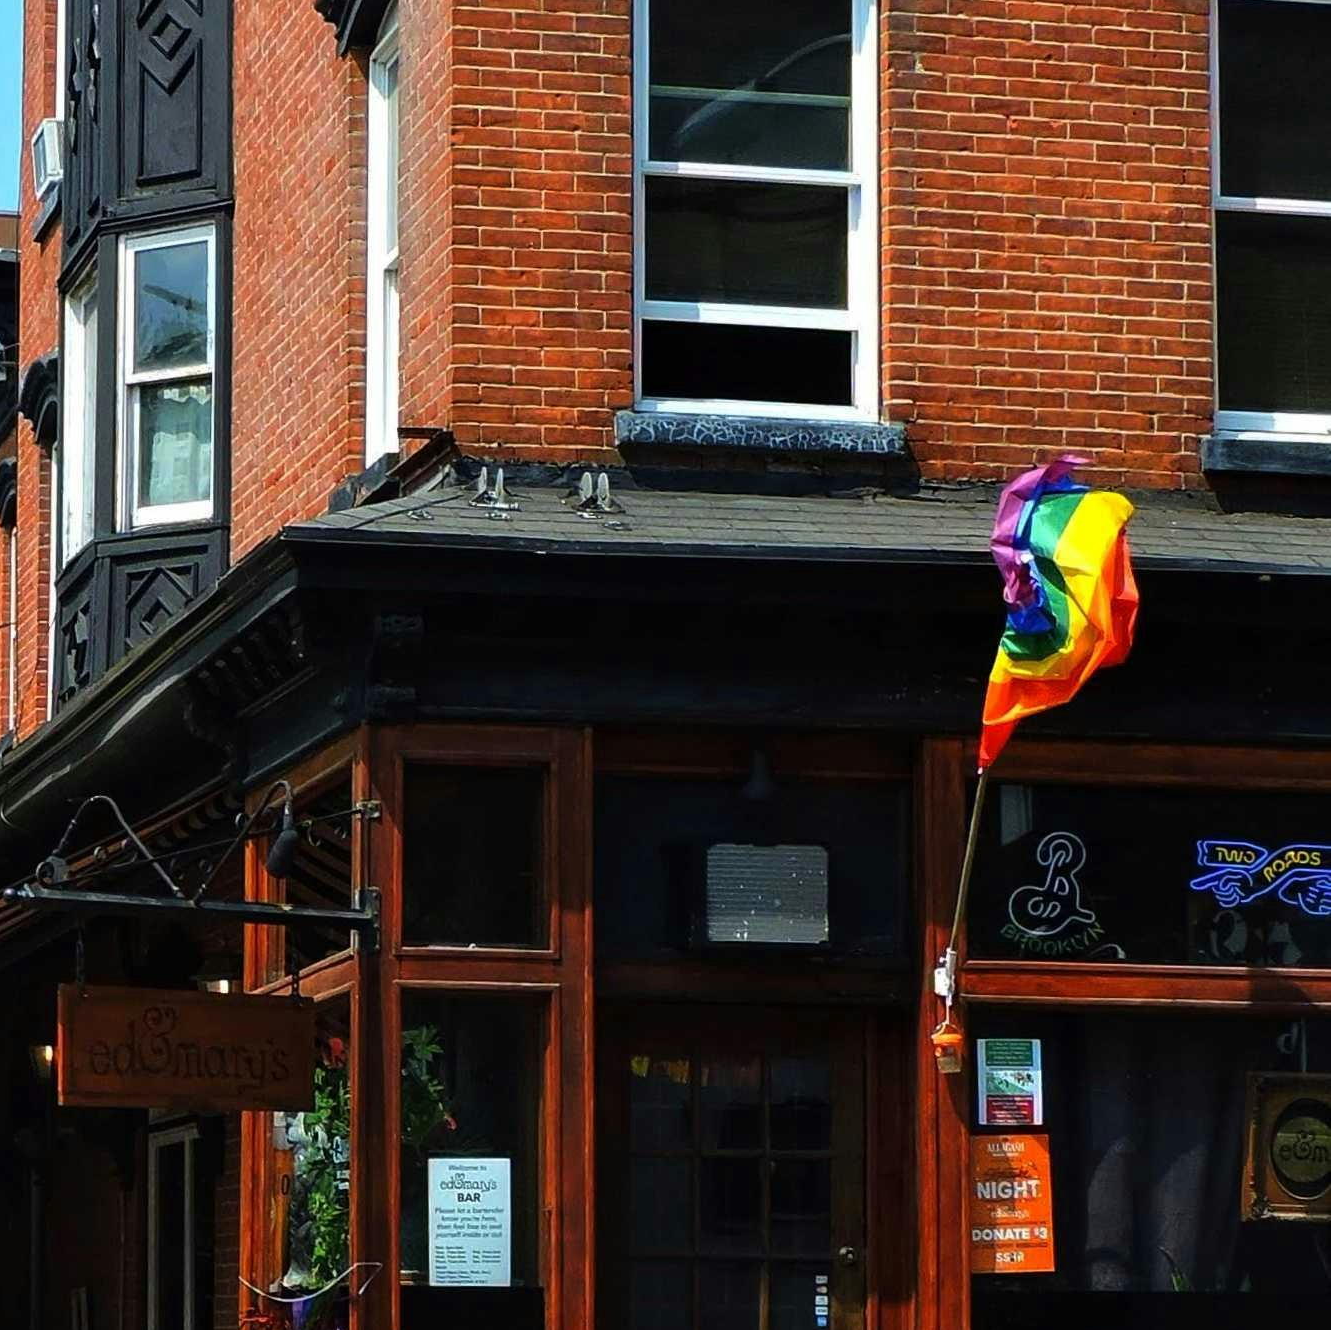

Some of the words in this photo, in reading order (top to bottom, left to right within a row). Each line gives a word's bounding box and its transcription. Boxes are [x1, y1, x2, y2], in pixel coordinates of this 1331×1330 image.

[1214, 847, 1256, 863] TWO
[1263, 851, 1322, 883] ROADS
[440, 1173, 498, 1193] ed&mary's
[977, 1180, 1040, 1199] NIGHT
[457, 1193, 481, 1202] BAR
[972, 1227, 1031, 1241] DONATE
